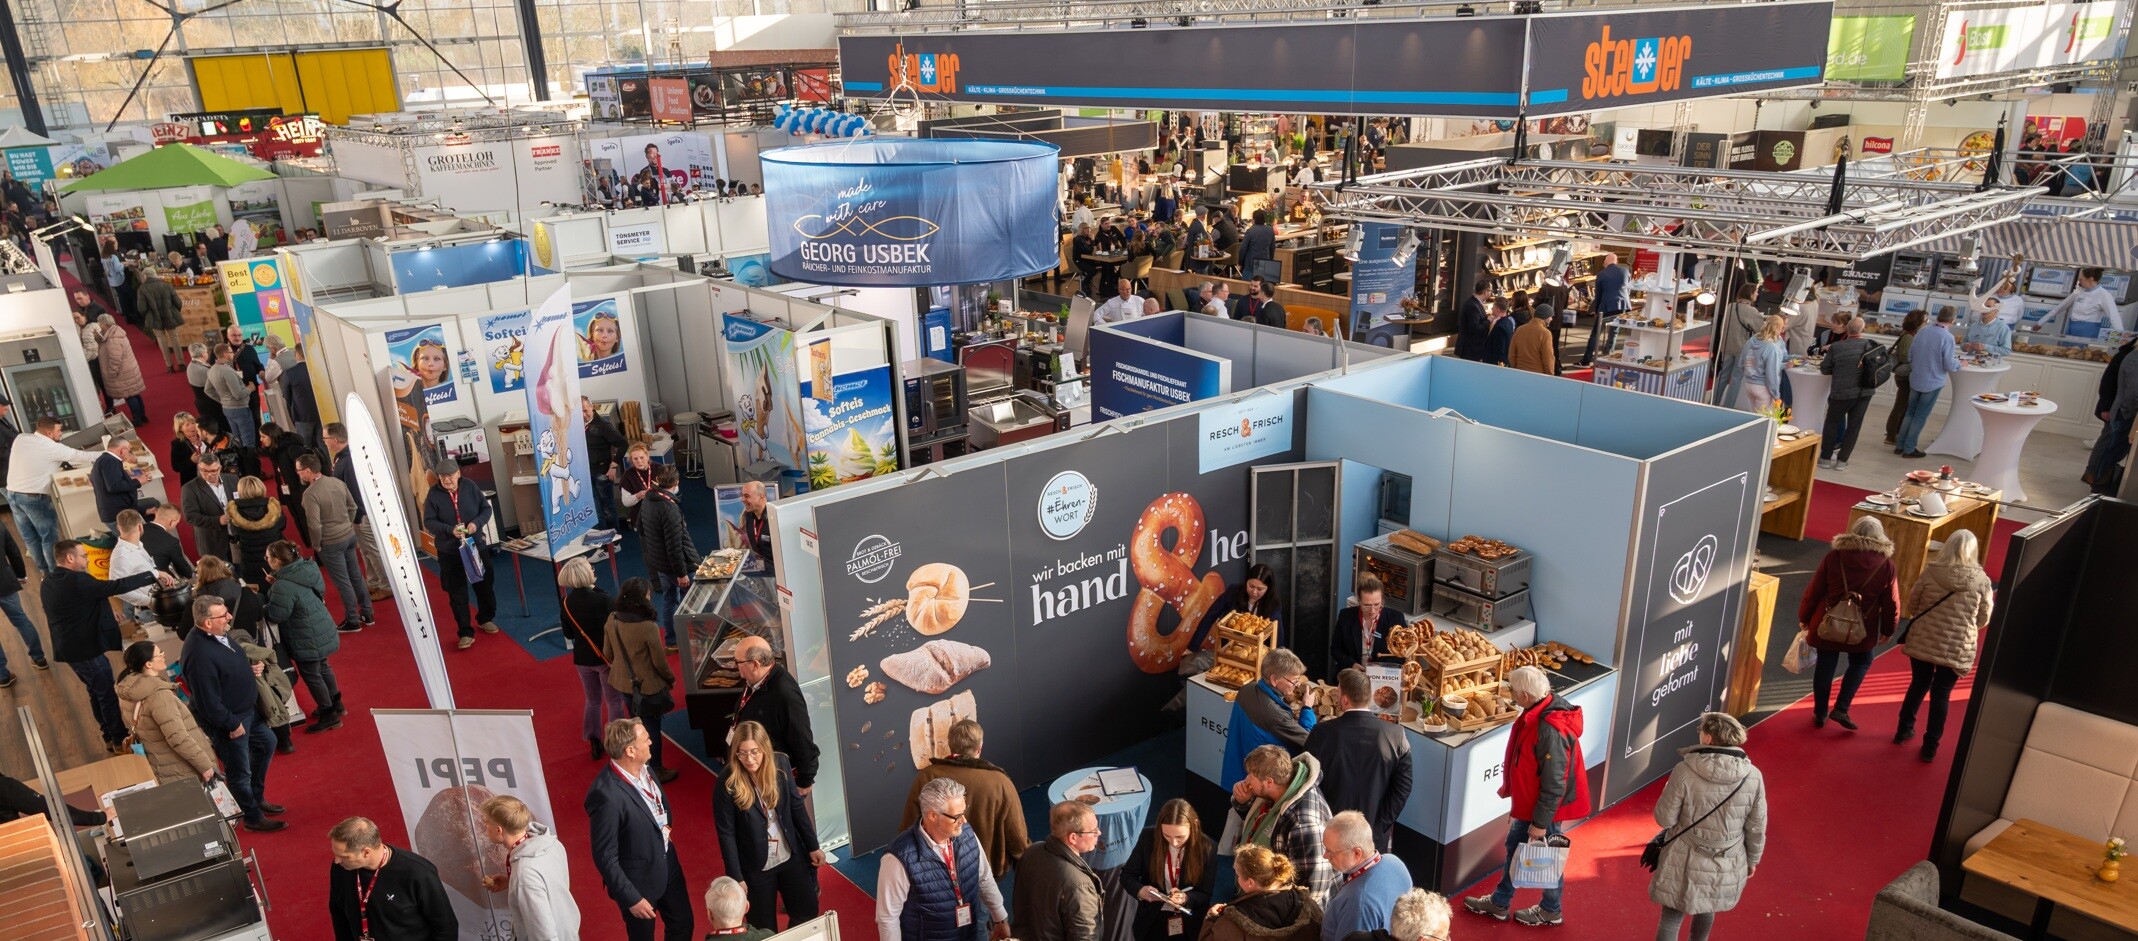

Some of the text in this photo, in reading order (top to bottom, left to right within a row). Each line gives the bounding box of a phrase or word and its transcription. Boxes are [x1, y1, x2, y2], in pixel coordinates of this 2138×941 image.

[1694, 152, 1712, 160] SINN
[1865, 141, 1891, 150] hilcona
[428, 151, 494, 165] GROTELOH
[430, 160, 495, 172] KAFFEEMASCHINEN
[838, 177, 872, 200] made
[172, 211, 190, 220] Aus
[825, 199, 887, 224] with care
[801, 241, 931, 264] GEORG USBEK
[227, 270, 248, 278] Best
[831, 264, 846, 273] UND
[848, 265, 932, 274] FEINKOSTMANUFAKTUR
[1842, 270, 1881, 279] SNACKT
[485, 326, 528, 341] Softei
[591, 359, 624, 376] Softeis!
[425, 387, 452, 405] ofteis!
[1112, 370, 1169, 396] FISCHMANUFAKTUR
[1169, 387, 1191, 403] USBEK
[829, 397, 864, 418] Softeis
[808, 404, 892, 444] Cannabis-Geschmack
[1210, 426, 1239, 441] RESCH
[1252, 415, 1283, 430] FRISCH
[549, 506, 594, 544] Softeis
[1054, 511, 1079, 523] WORT
[846, 545, 902, 573] PALMÖL-FREI
[1032, 543, 1126, 583] wir backen mit
[1030, 558, 1128, 627] hand
[1209, 526, 1249, 568] he
[1674, 619, 1694, 644] mit
[1659, 642, 1699, 678] liebe
[1652, 665, 1699, 707] geformt
[1201, 717, 1229, 738] RESC
